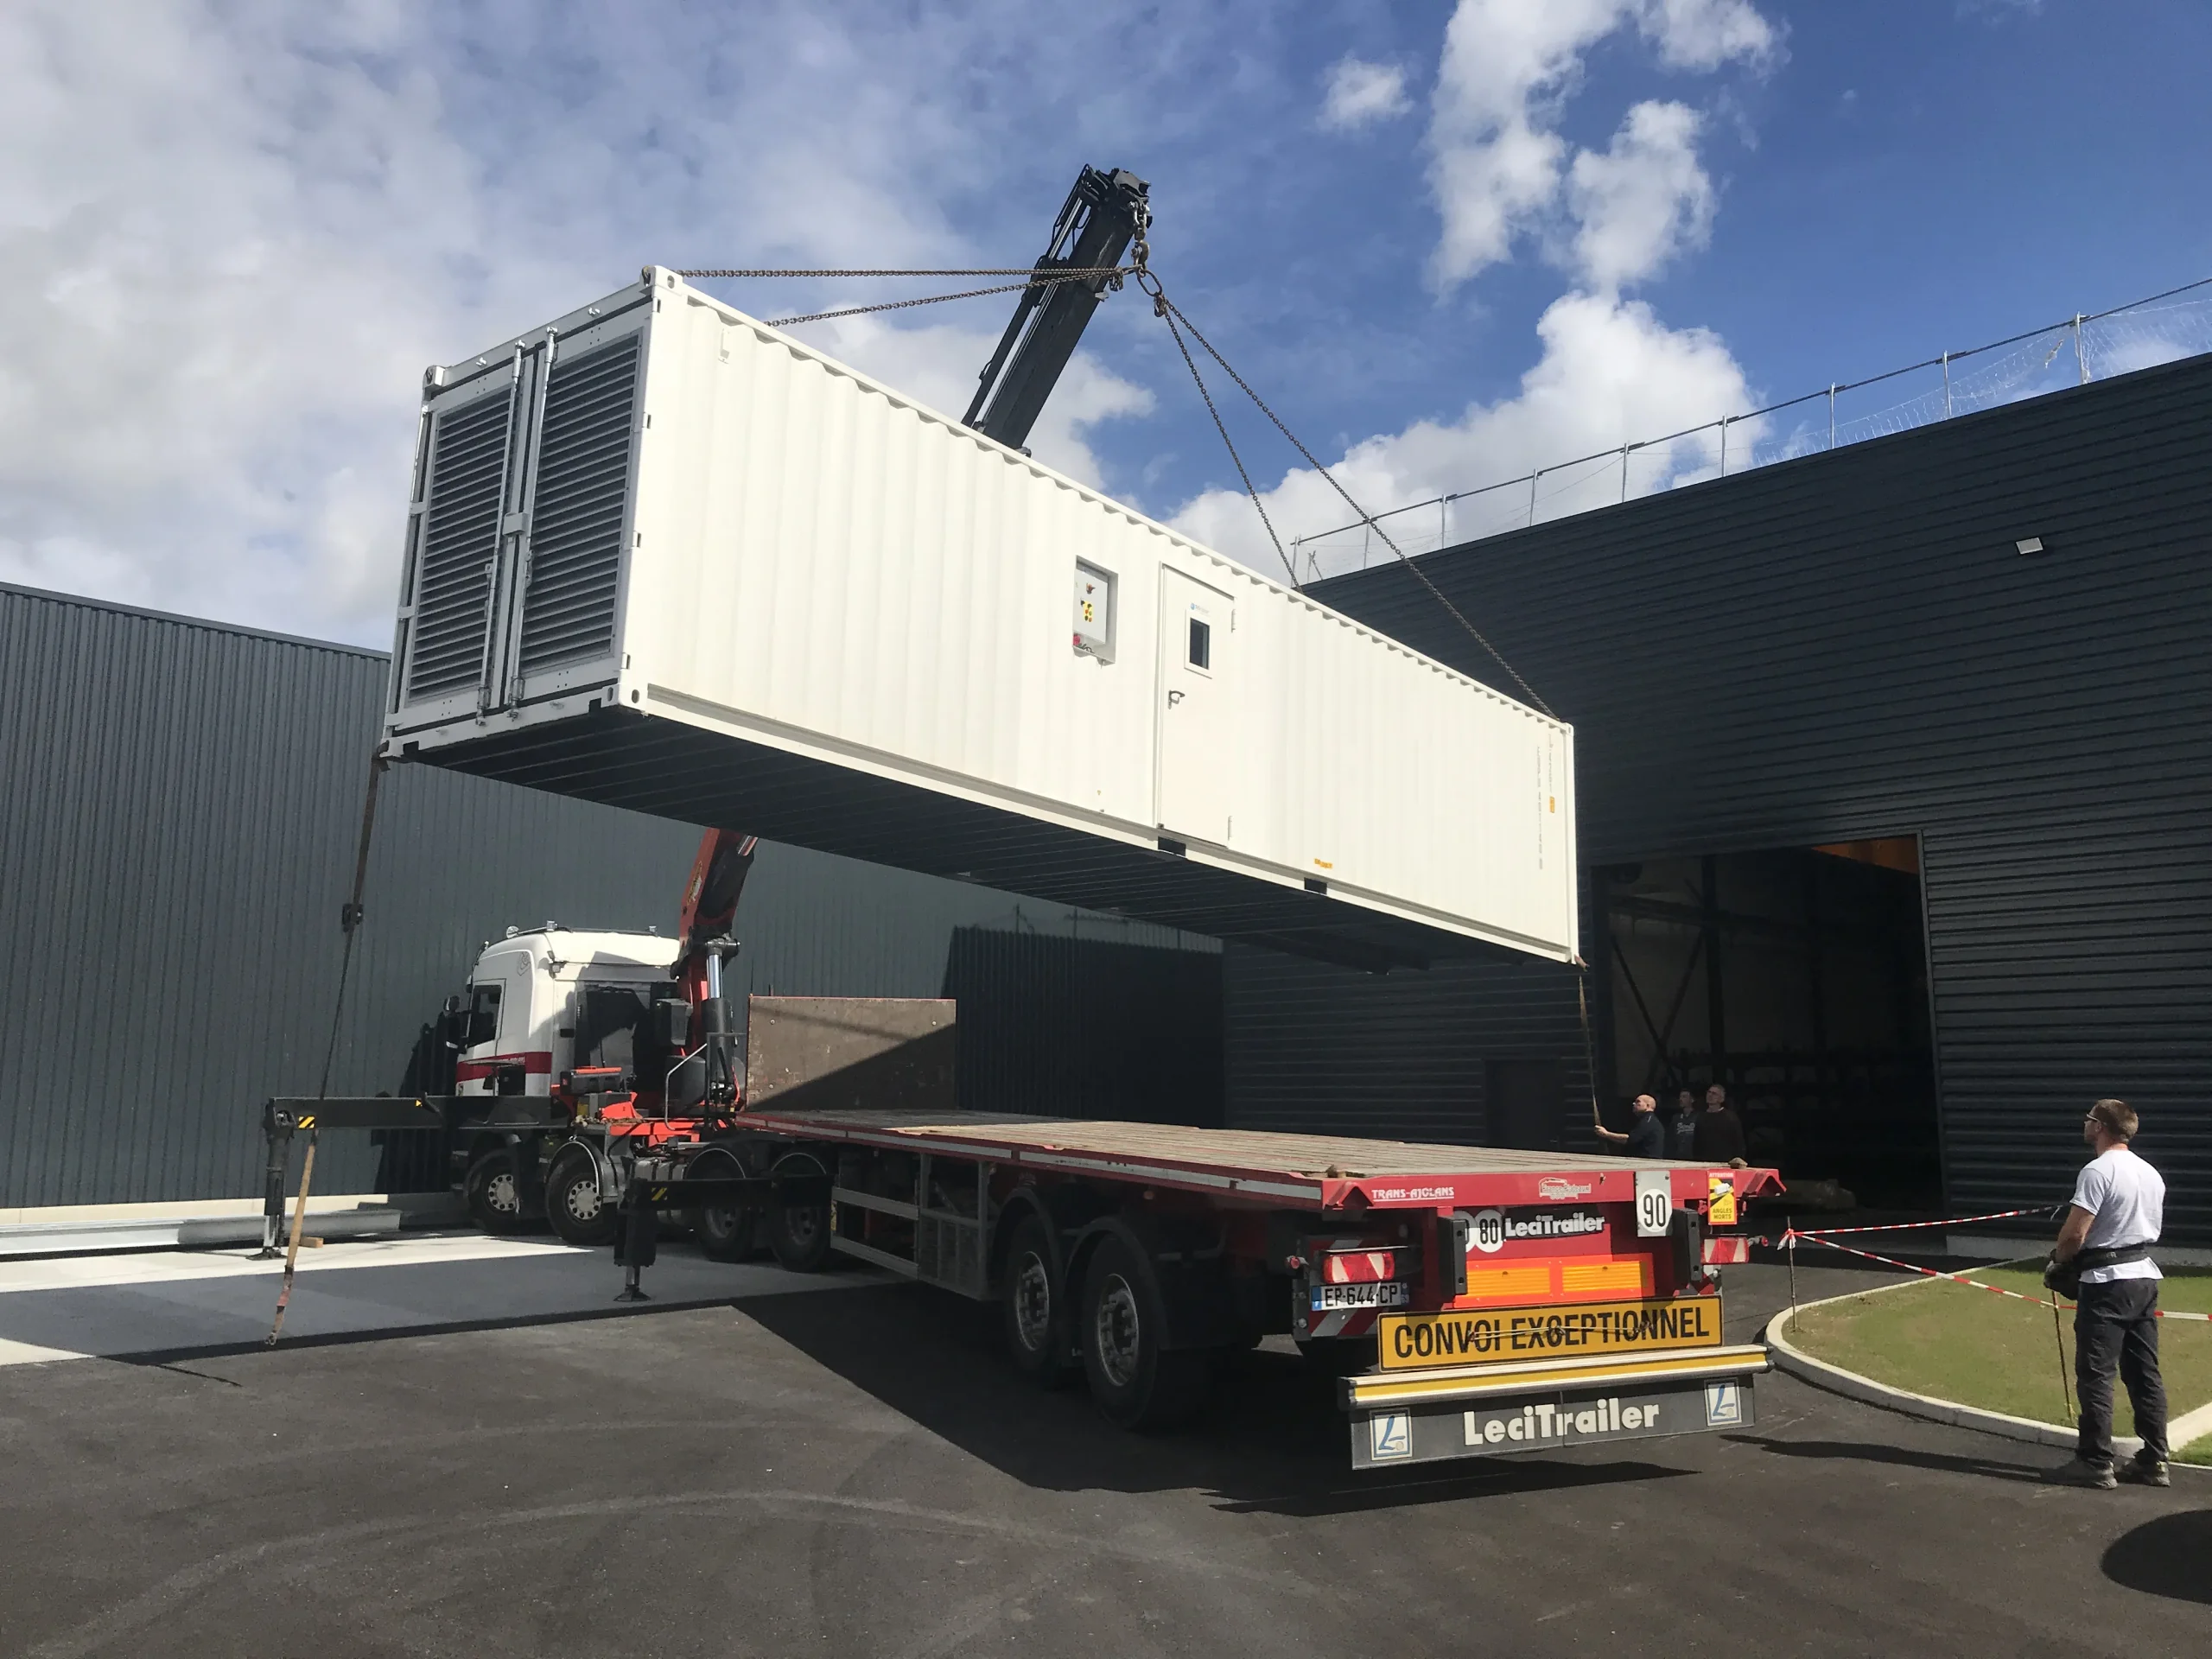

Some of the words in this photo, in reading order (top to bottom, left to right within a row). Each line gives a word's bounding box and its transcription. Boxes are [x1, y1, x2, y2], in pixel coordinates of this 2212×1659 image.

[1505, 1212, 1605, 1236] LeciTrailer
[1643, 1194, 1666, 1227] 90
[1479, 1218, 1498, 1244] 80
[1395, 1319, 1500, 1358] CONVOI
[1512, 1306, 1710, 1350] EXCEPTIONNEL
[1464, 1397, 1660, 1446] LeciTrailer
